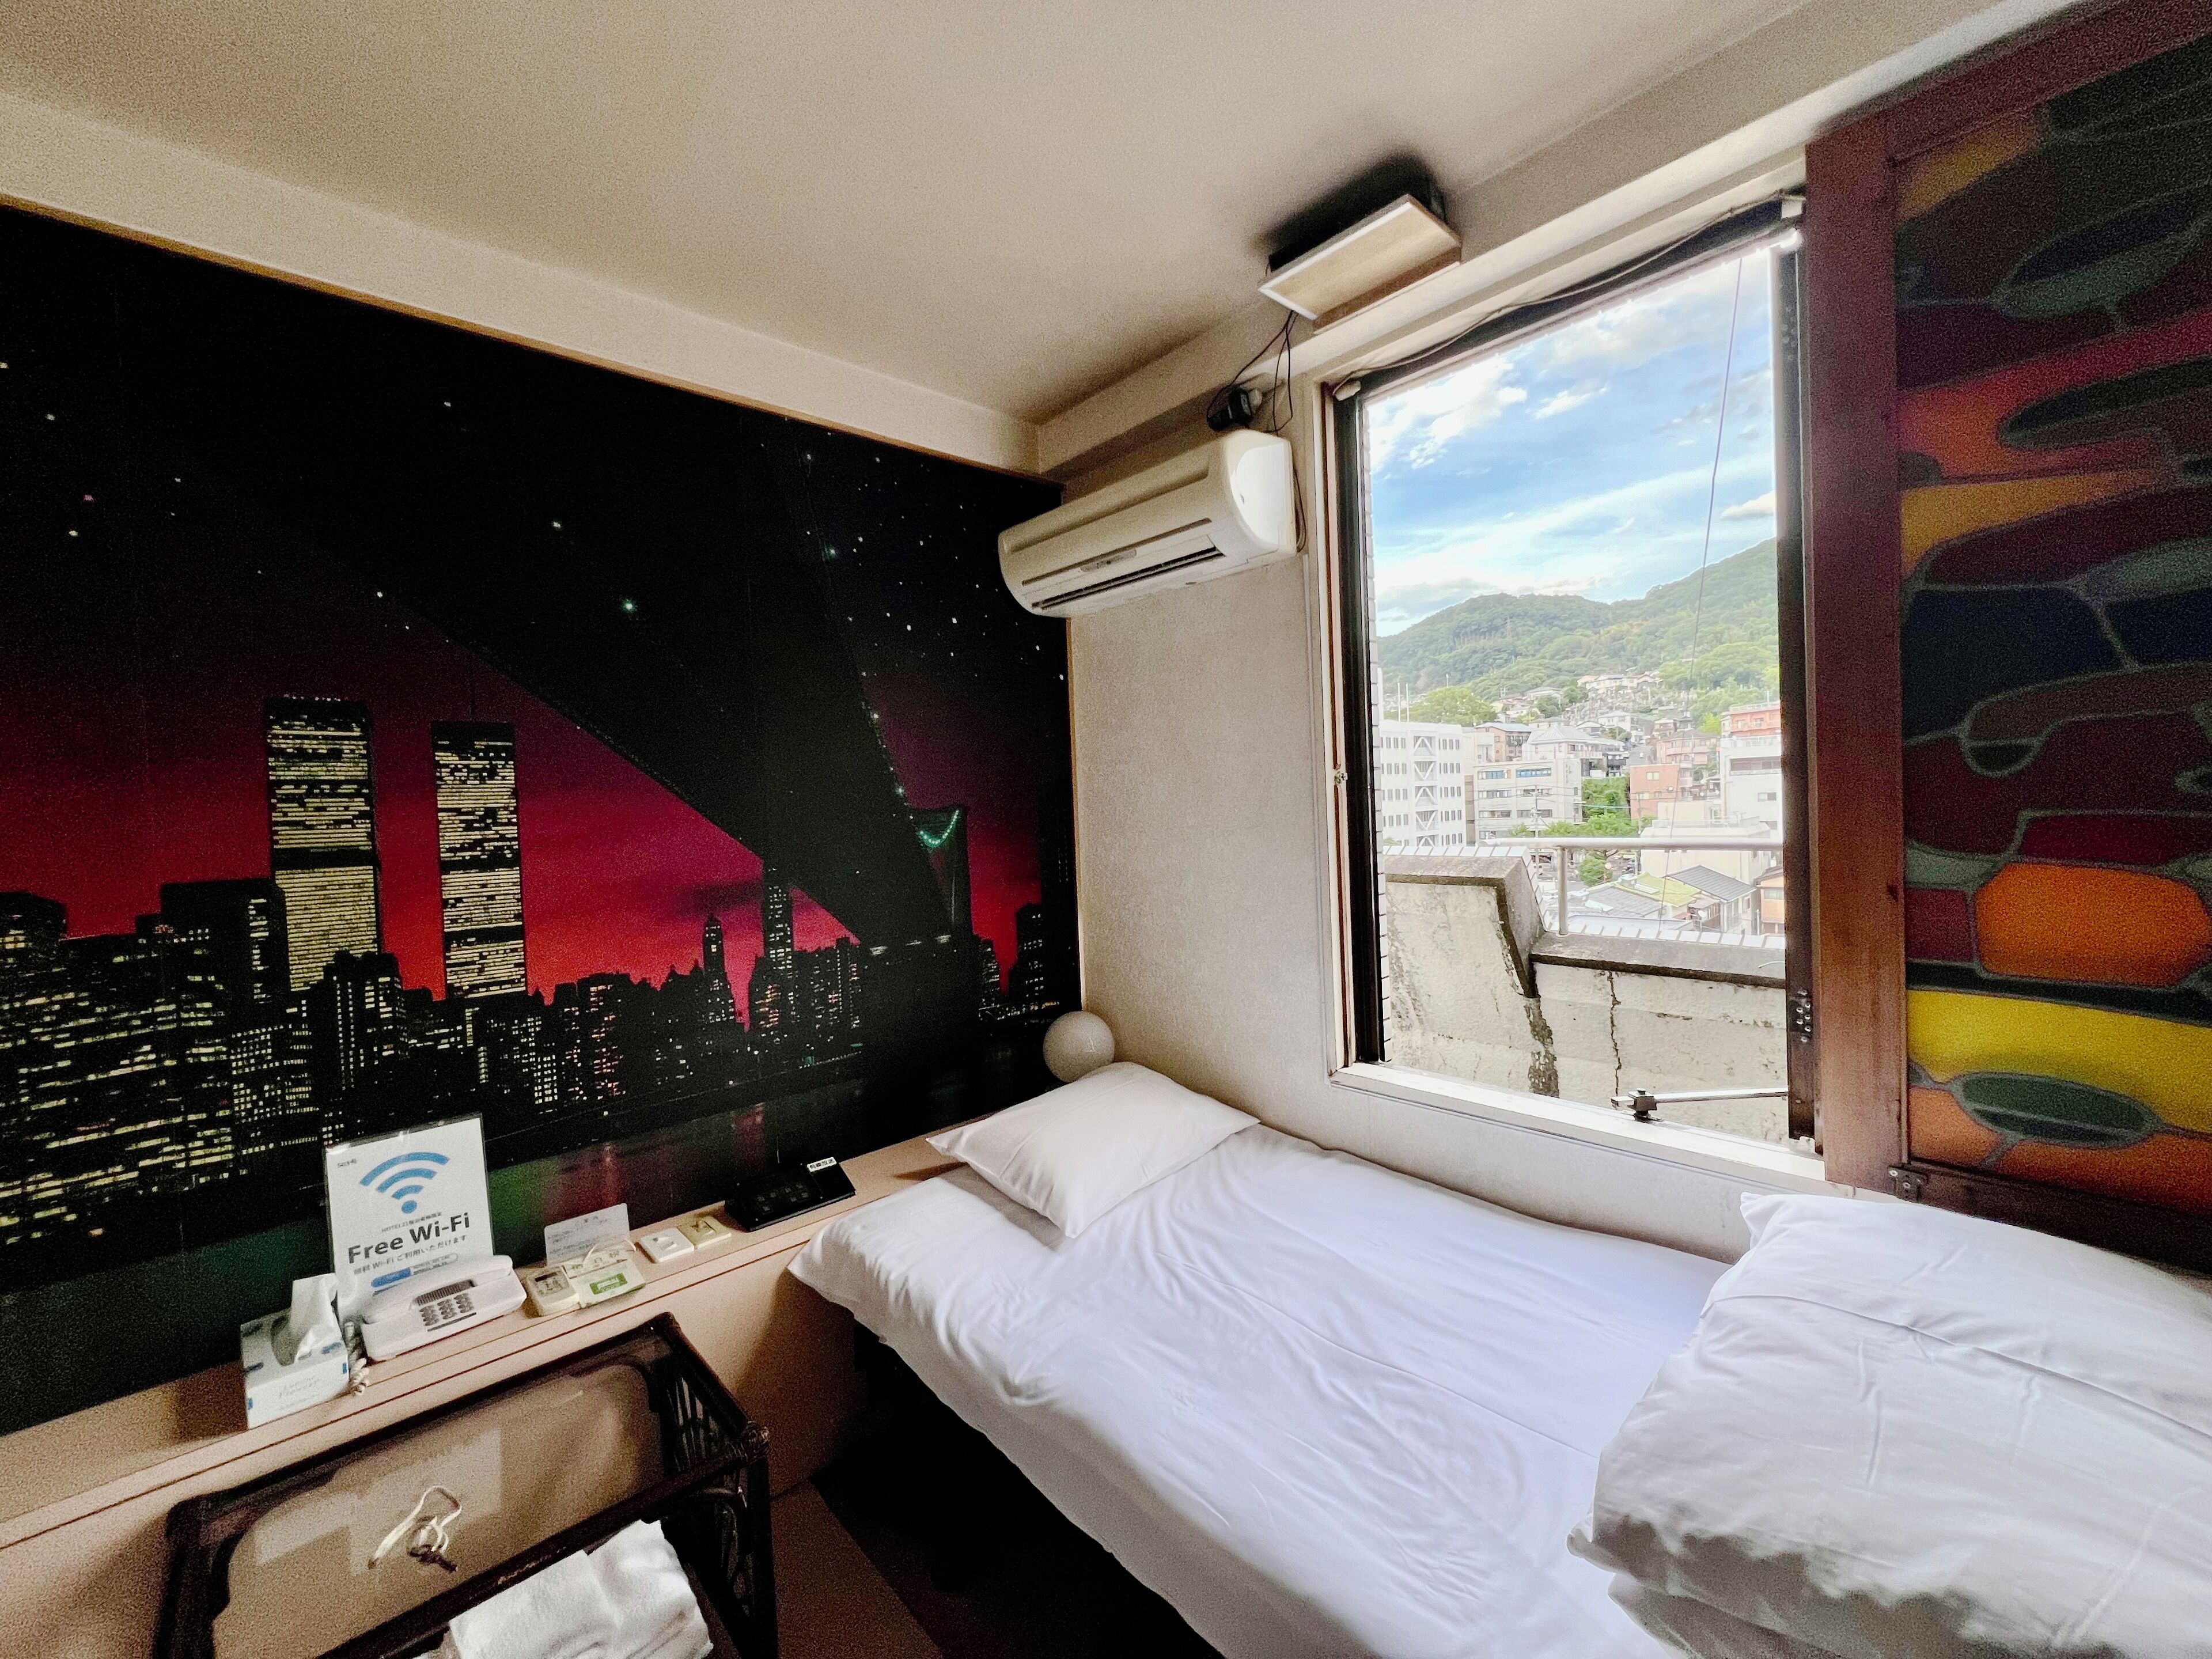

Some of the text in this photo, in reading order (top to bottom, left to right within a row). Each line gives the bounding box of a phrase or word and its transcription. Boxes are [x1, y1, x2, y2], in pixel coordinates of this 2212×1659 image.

[348, 1237, 403, 1264] Free
[410, 1212, 469, 1244] Wi-Fi
[372, 1257, 394, 1269] Wi-Fi
